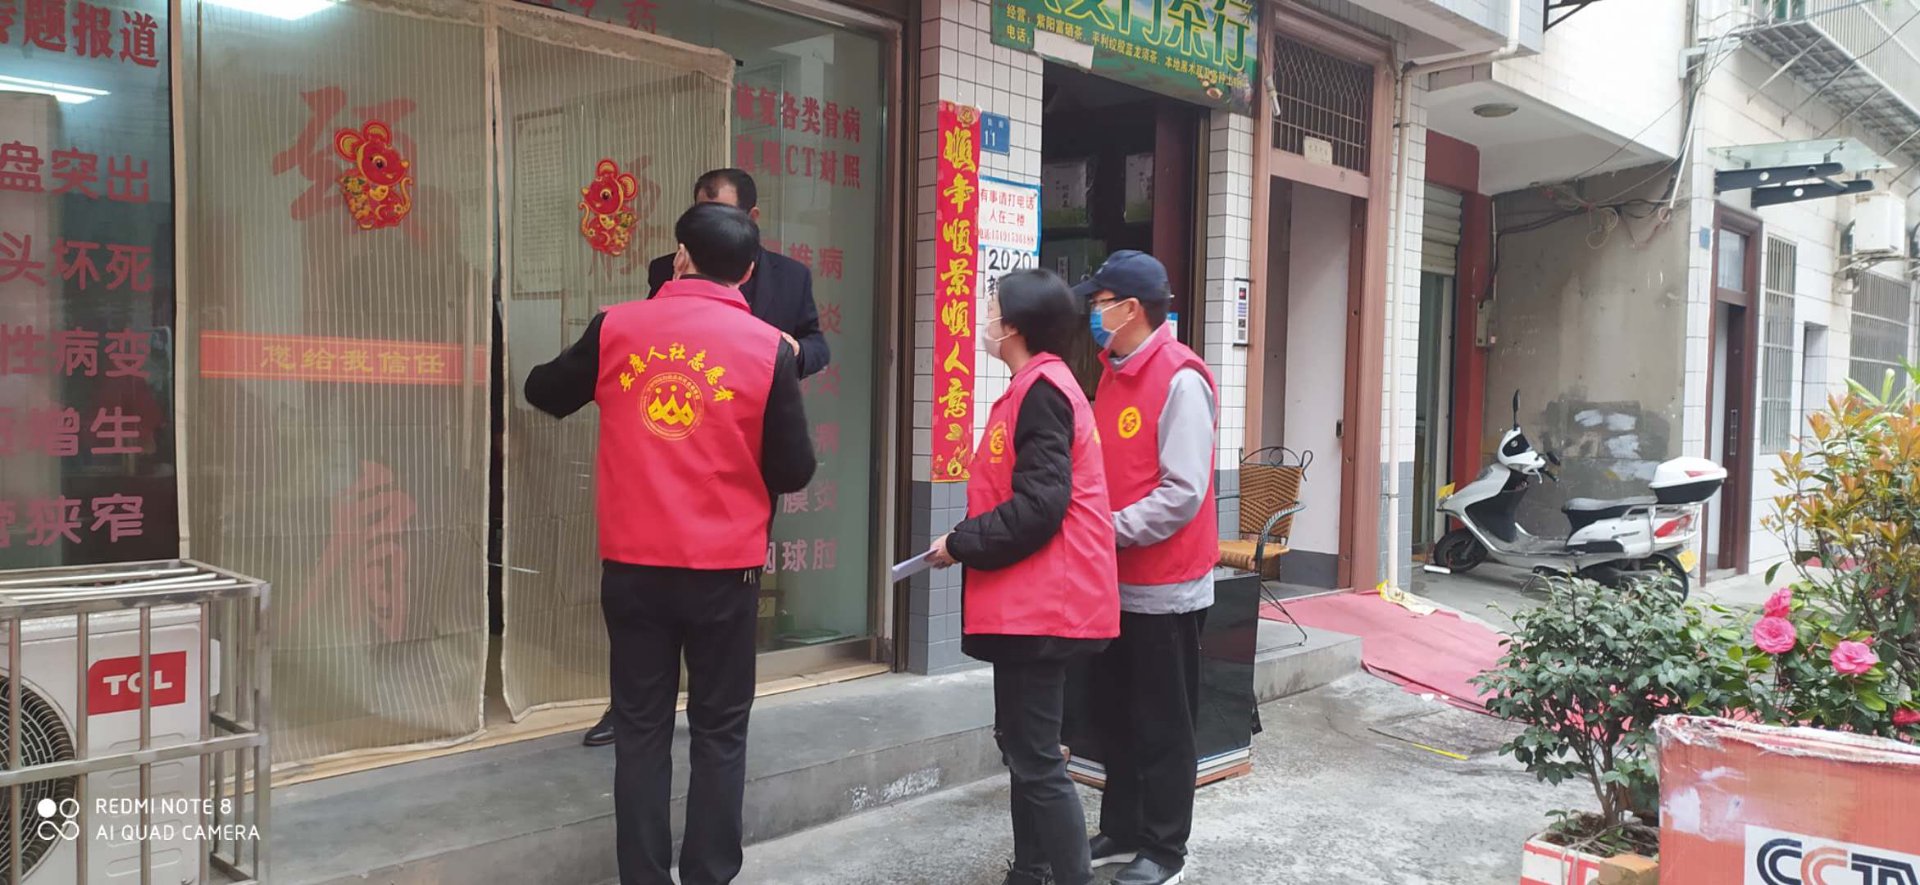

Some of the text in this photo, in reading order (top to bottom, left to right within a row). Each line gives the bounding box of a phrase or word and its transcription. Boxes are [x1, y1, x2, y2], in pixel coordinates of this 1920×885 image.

[0, 141, 149, 203] 盘突出
[980, 188, 1034, 210] 有事请打电话
[989, 208, 1025, 226] 人在二楼
[0, 231, 153, 292] 头坏死
[988, 248, 1032, 271] 2020
[0, 324, 152, 379] 性病变
[102, 670, 173, 696] TCL
